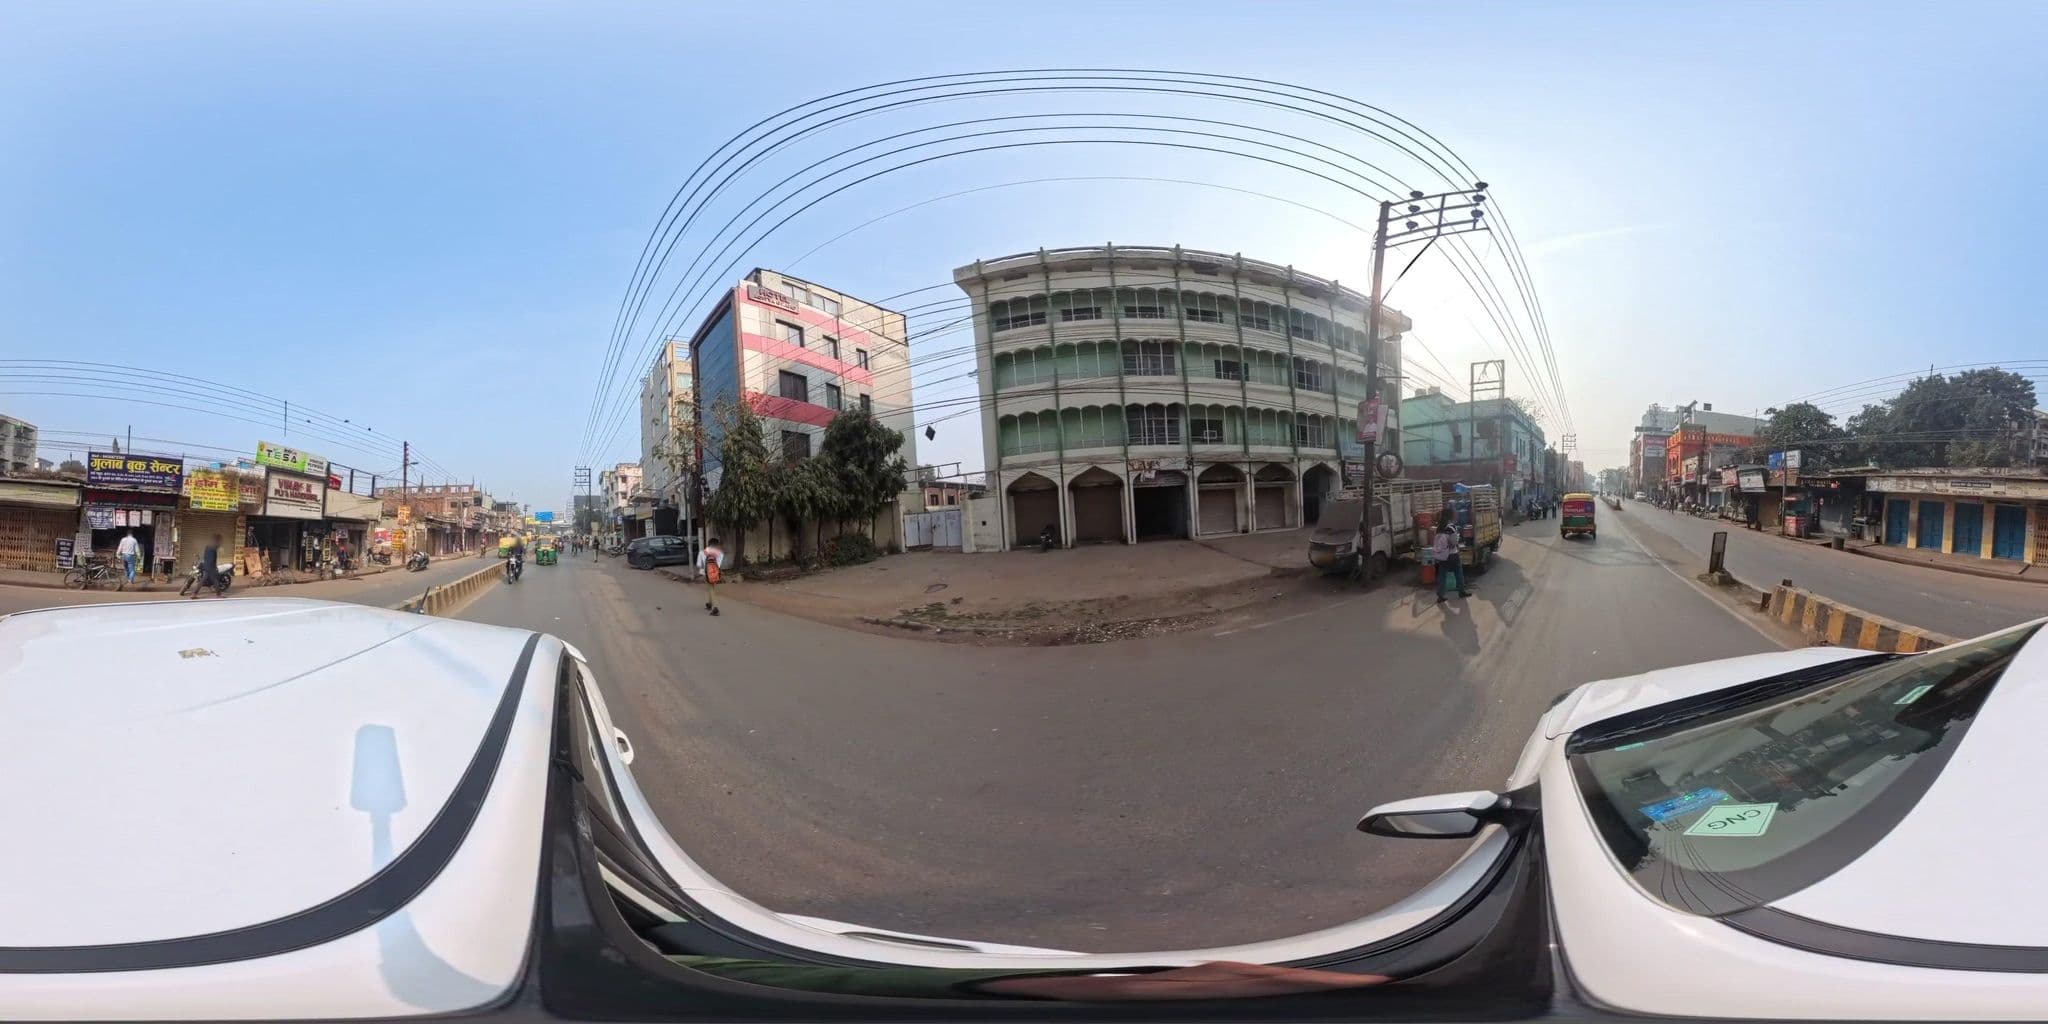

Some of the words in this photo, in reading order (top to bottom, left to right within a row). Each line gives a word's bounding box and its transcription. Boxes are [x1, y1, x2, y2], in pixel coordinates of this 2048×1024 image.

[266, 448, 297, 464] TESA
[90, 458, 124, 471] गुलाब
[127, 460, 147, 473] बुक
[1707, 809, 1761, 830] CNG
